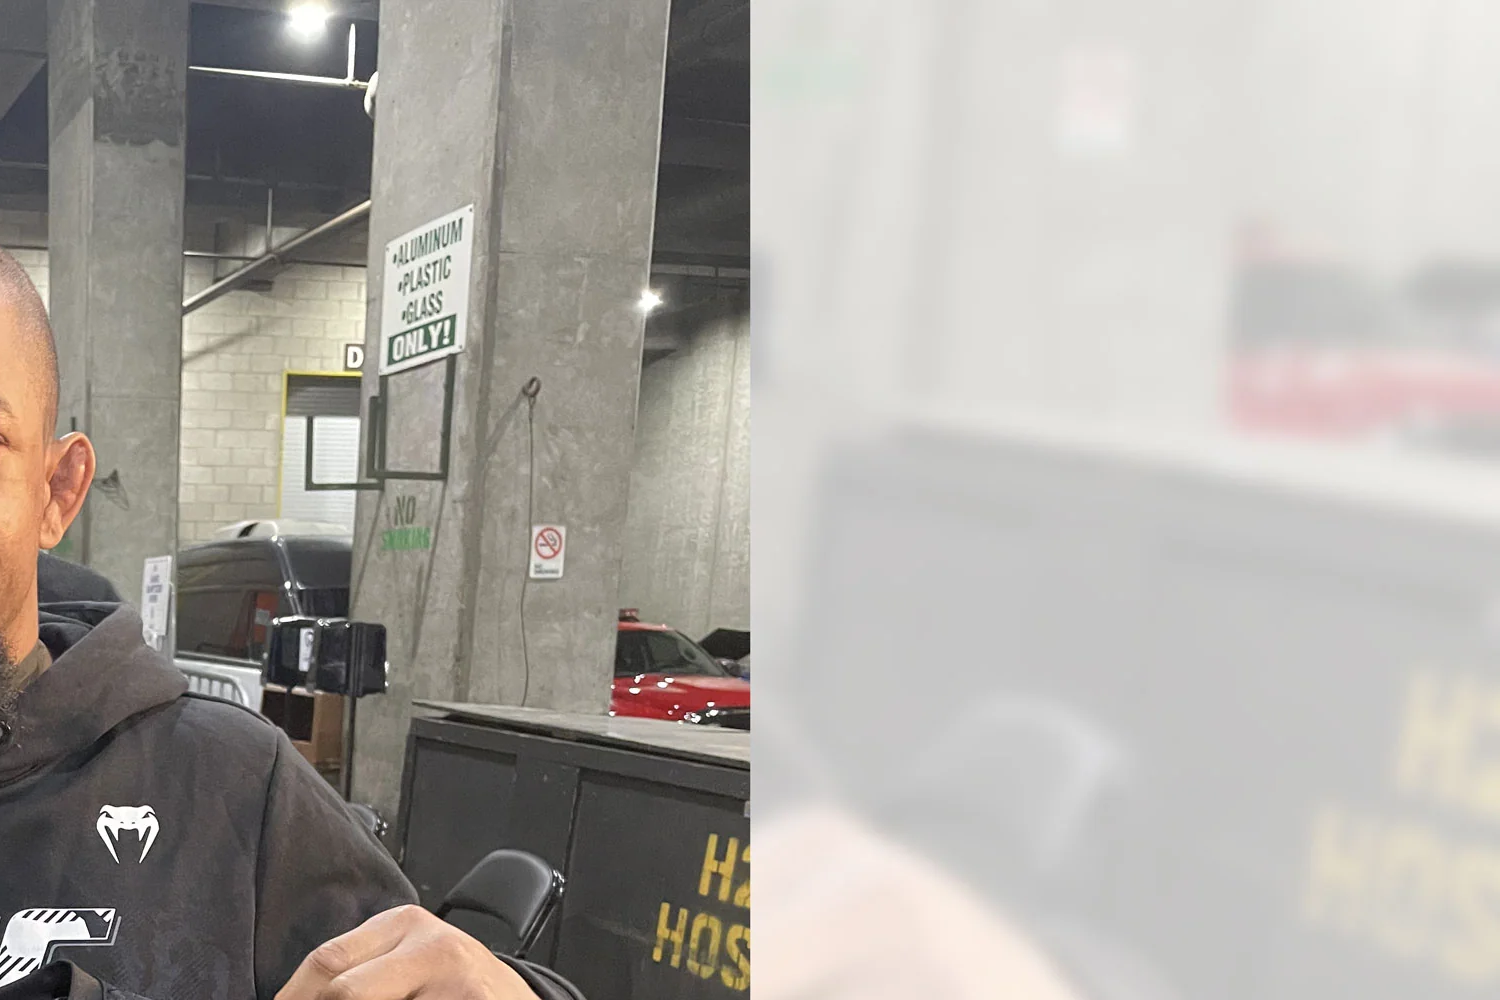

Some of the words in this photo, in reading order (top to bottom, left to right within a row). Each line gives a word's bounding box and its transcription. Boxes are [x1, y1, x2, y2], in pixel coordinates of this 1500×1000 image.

[396, 216, 464, 269] ALUMINUM
[402, 255, 452, 297] PLASTIC
[406, 290, 444, 325] GLASS
[392, 317, 451, 361] ONLY!
[393, 495, 417, 527] NO
